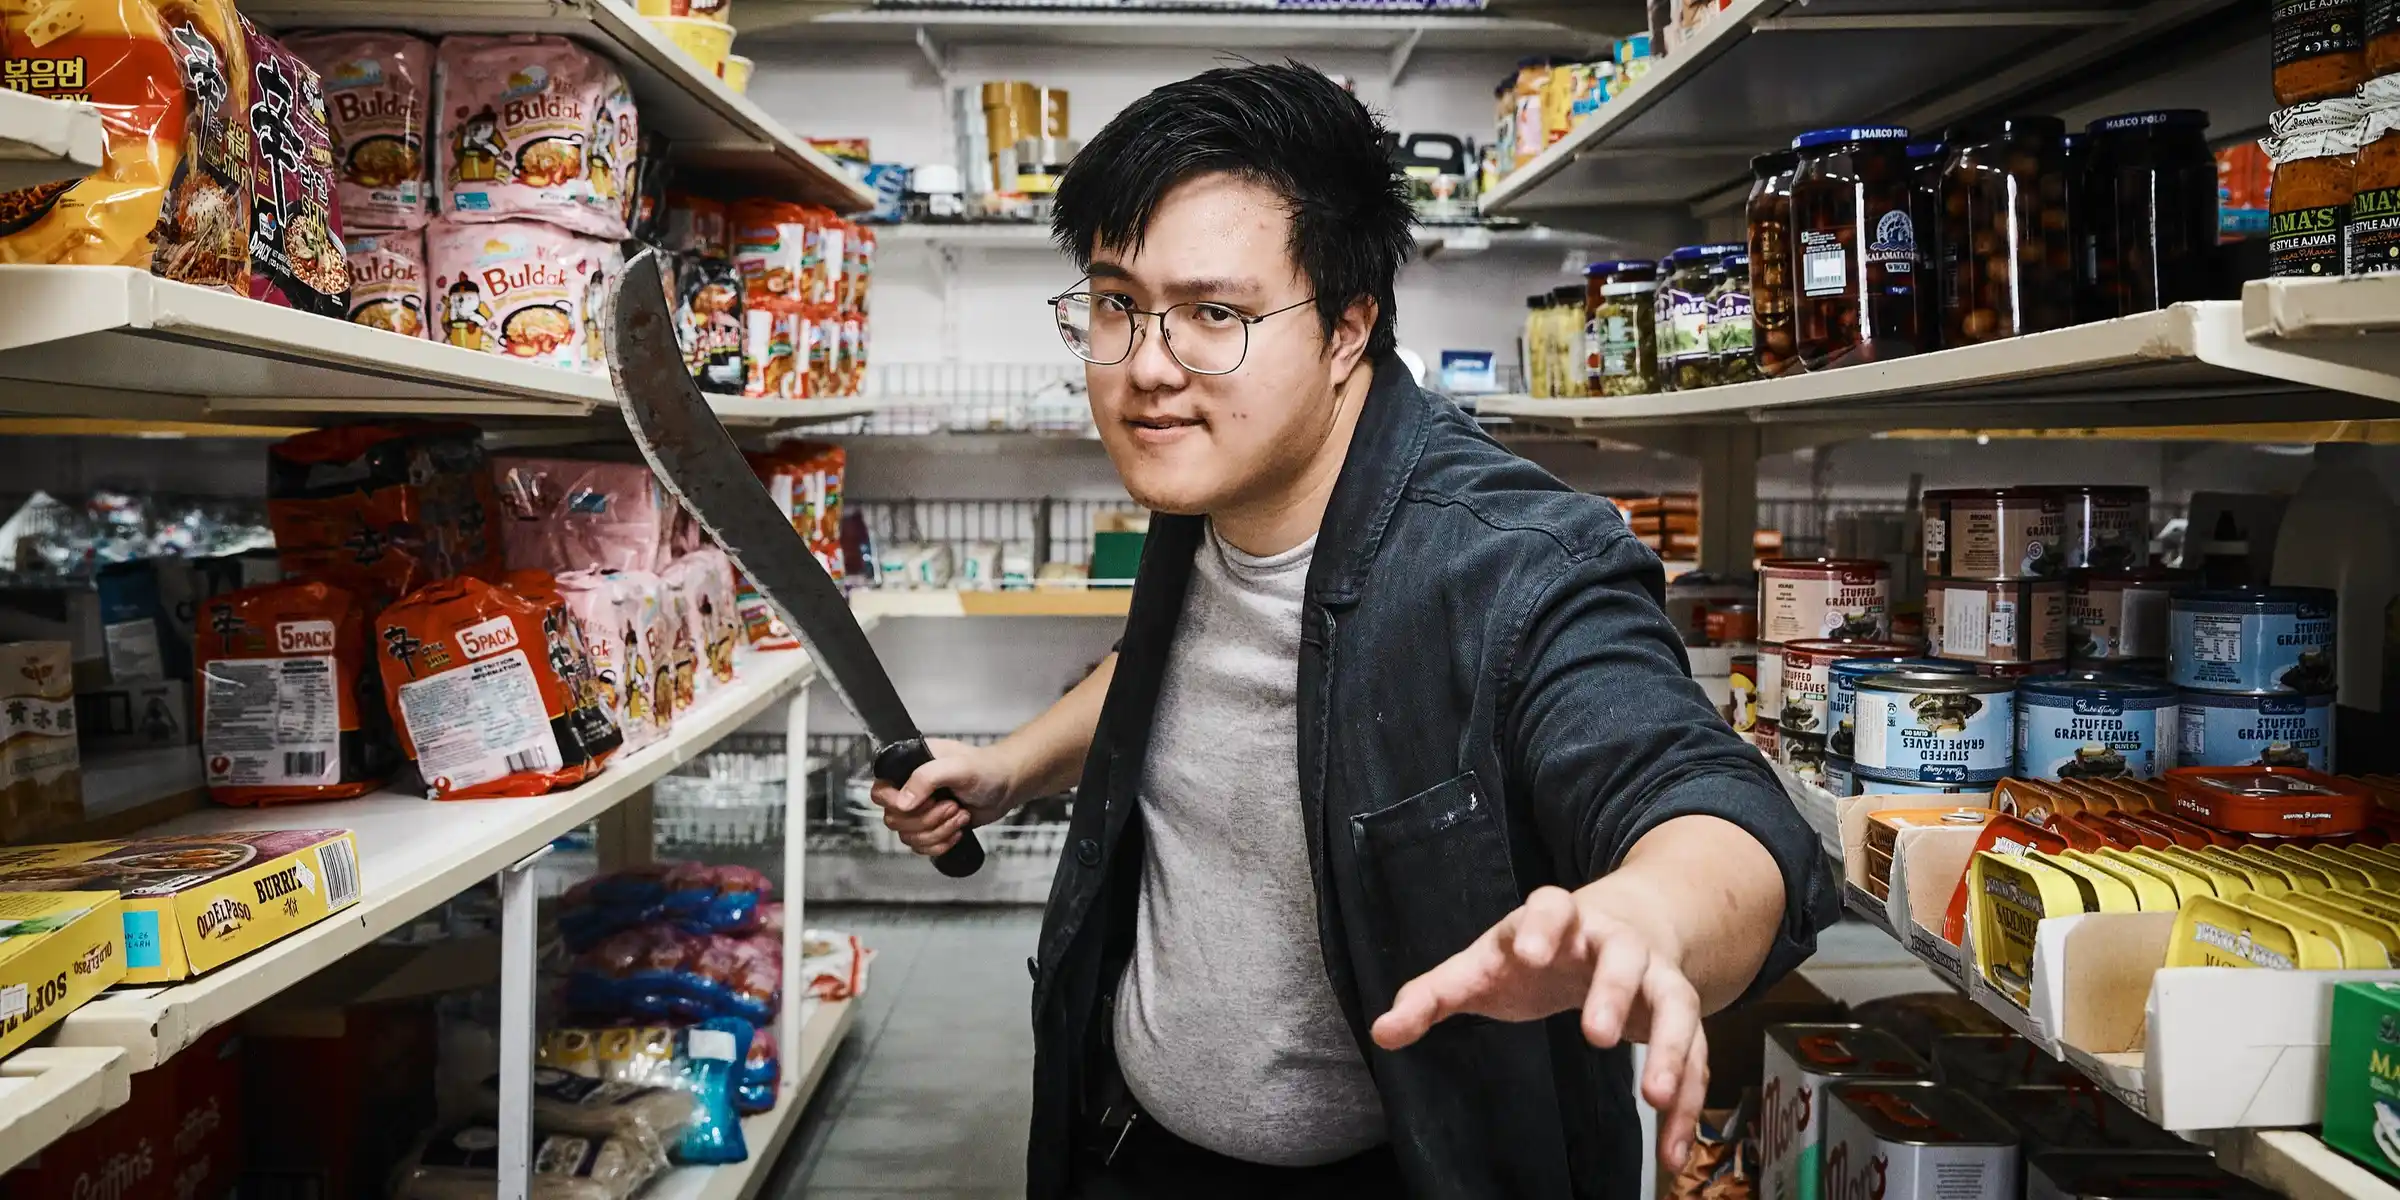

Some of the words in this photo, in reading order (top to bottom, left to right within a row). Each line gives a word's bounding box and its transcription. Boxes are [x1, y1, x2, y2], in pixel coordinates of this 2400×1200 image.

[2287, 0, 2316, 15] STYLE
[4, 56, 84, 94] 볶음면
[333, 89, 422, 126] Buldak
[502, 94, 583, 127] Buldak
[2106, 116, 2138, 129] MARCO
[2140, 113, 2167, 124] POLO
[250, 54, 305, 228] 辛
[1860, 129, 1893, 139] MARCO
[2270, 207, 2334, 236] AMA'S
[2356, 220, 2378, 232] STYLE
[2276, 238, 2299, 250] STYLE
[2301, 234, 2336, 247] AJVAR
[347, 256, 421, 288] Buldak
[482, 264, 568, 298] Buldak
[1840, 587, 1876, 597] STUFFED
[1825, 597, 1857, 607] GRAPE
[2277, 634, 2312, 646] GRAPE
[1784, 670, 1811, 682] STUFFED
[1795, 682, 1826, 694] LEAVES
[1837, 693, 1854, 704] STUF
[2071, 718, 2123, 731] STUFFED
[2257, 718, 2306, 729] STUFFED
[2054, 728, 2093, 741] GRAPE
[2098, 730, 2140, 742] LEAVES
[2238, 728, 2279, 741] GRAPE
[2284, 727, 2320, 741] LEAVES
[1903, 737, 1944, 749] LEAVES
[1949, 739, 1985, 750] GRAPE
[1920, 750, 1969, 761] STUFFED
[197, 911, 217, 941] OLD
[212, 901, 228, 925] EL
[99, 941, 112, 965] OLD
[21, 971, 68, 1022] SOFT
